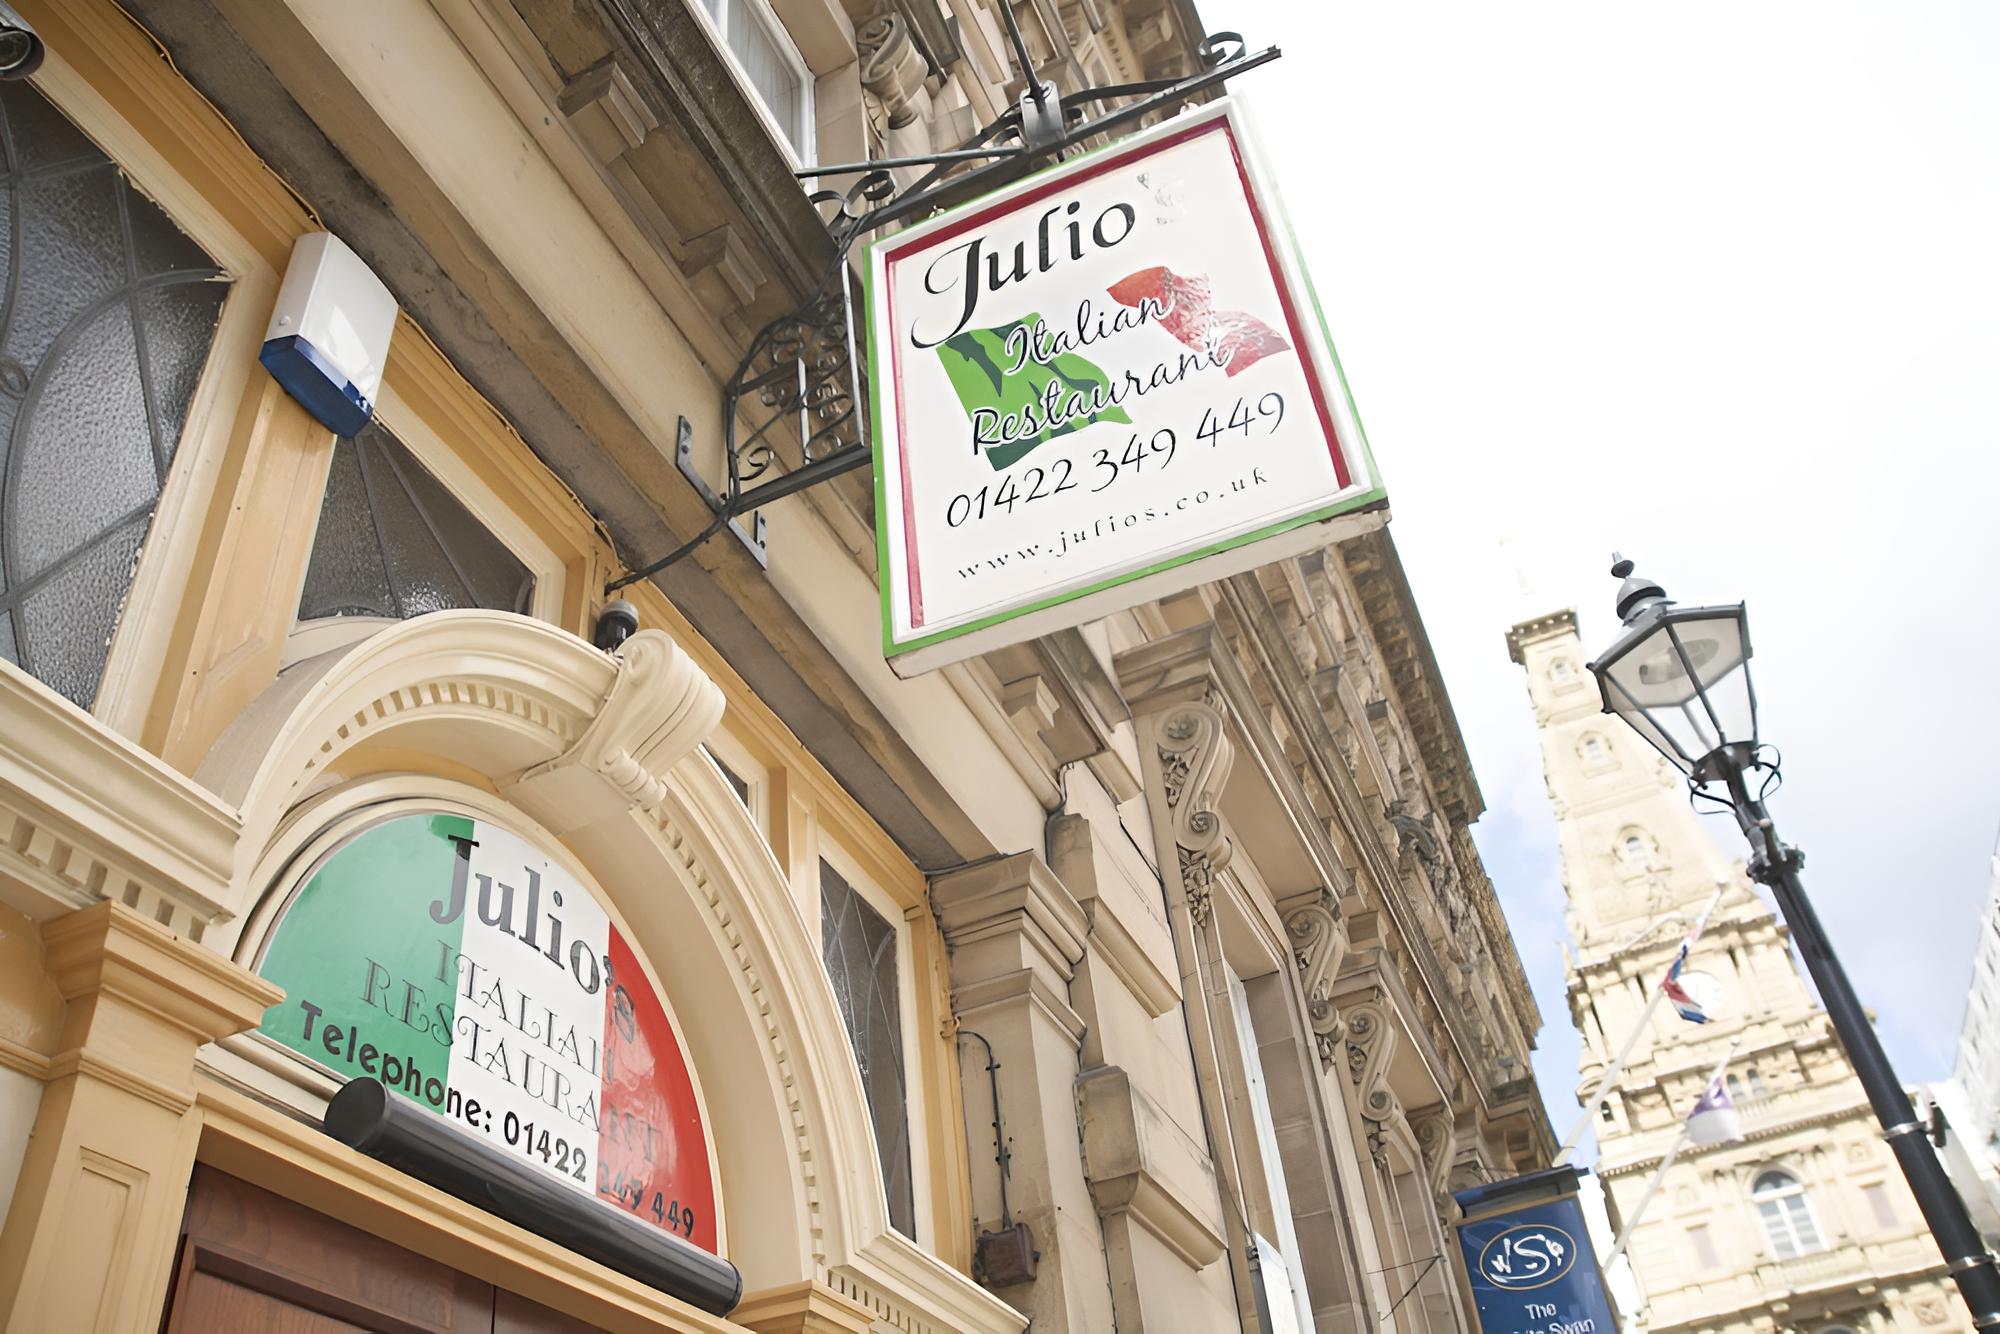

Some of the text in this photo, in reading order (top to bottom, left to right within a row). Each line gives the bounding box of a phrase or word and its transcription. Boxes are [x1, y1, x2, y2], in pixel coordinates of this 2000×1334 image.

[1004, 297, 1171, 375] Italian
[946, 391, 1286, 530] 01422 349 449
[956, 466, 1269, 579] www.julios.co.uk
[300, 1000, 493, 1133] Telephone:
[503, 1110, 588, 1183] 01422
[652, 1191, 695, 1239] 449
